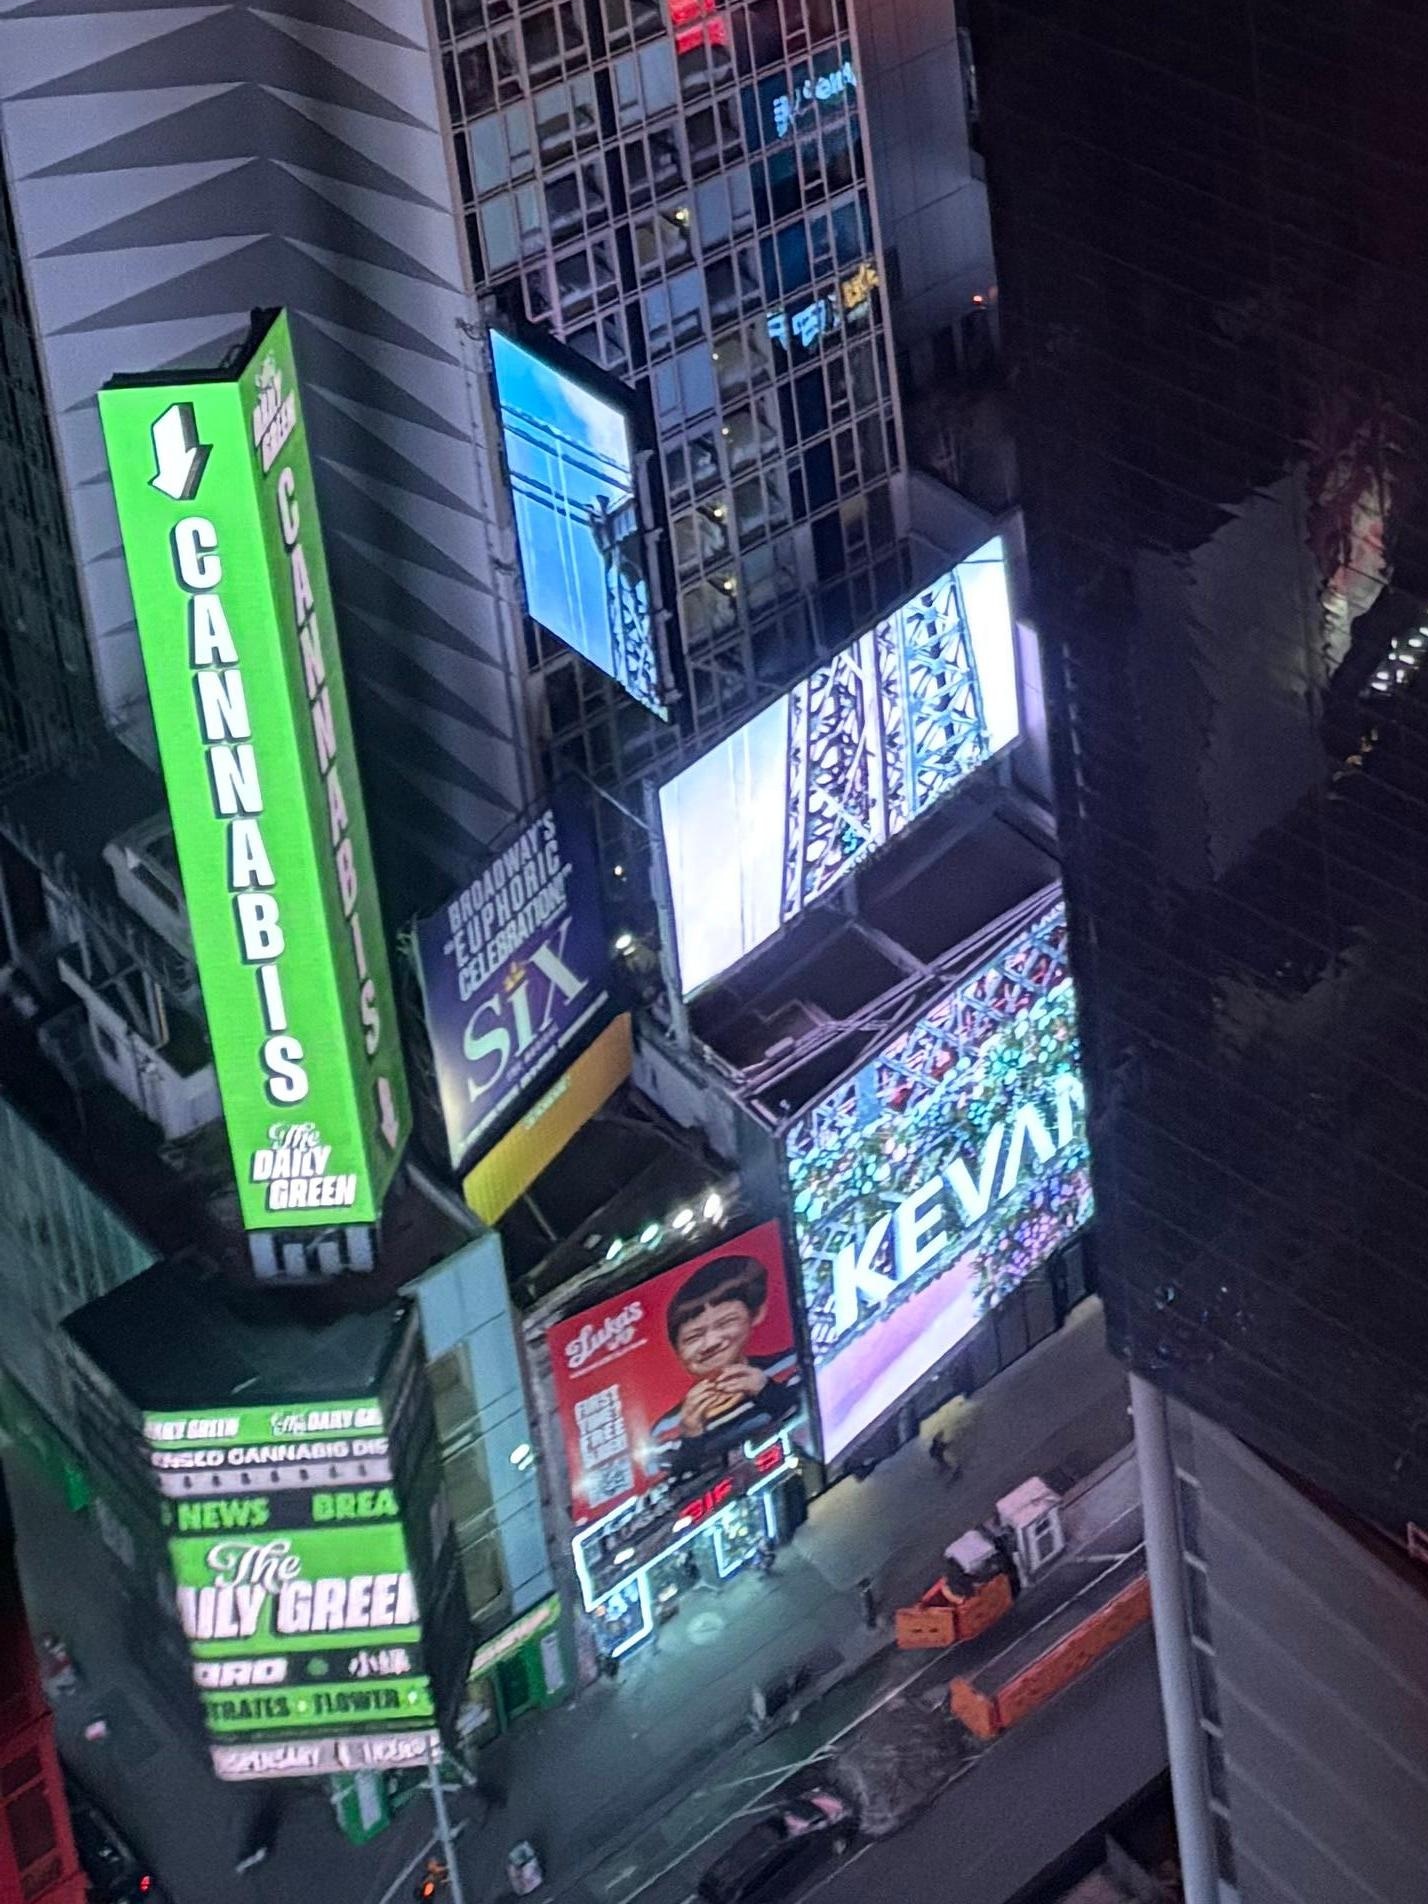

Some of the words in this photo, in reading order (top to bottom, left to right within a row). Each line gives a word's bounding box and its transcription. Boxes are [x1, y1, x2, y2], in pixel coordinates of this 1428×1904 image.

[171, 515, 309, 1104] CANNABIS
[462, 915, 589, 1103] SIX
[252, 1145, 331, 1183] DAILY
[266, 1175, 357, 1210] GREEN
[176, 1496, 270, 1532] NEWS
[206, 1537, 302, 1594] The
